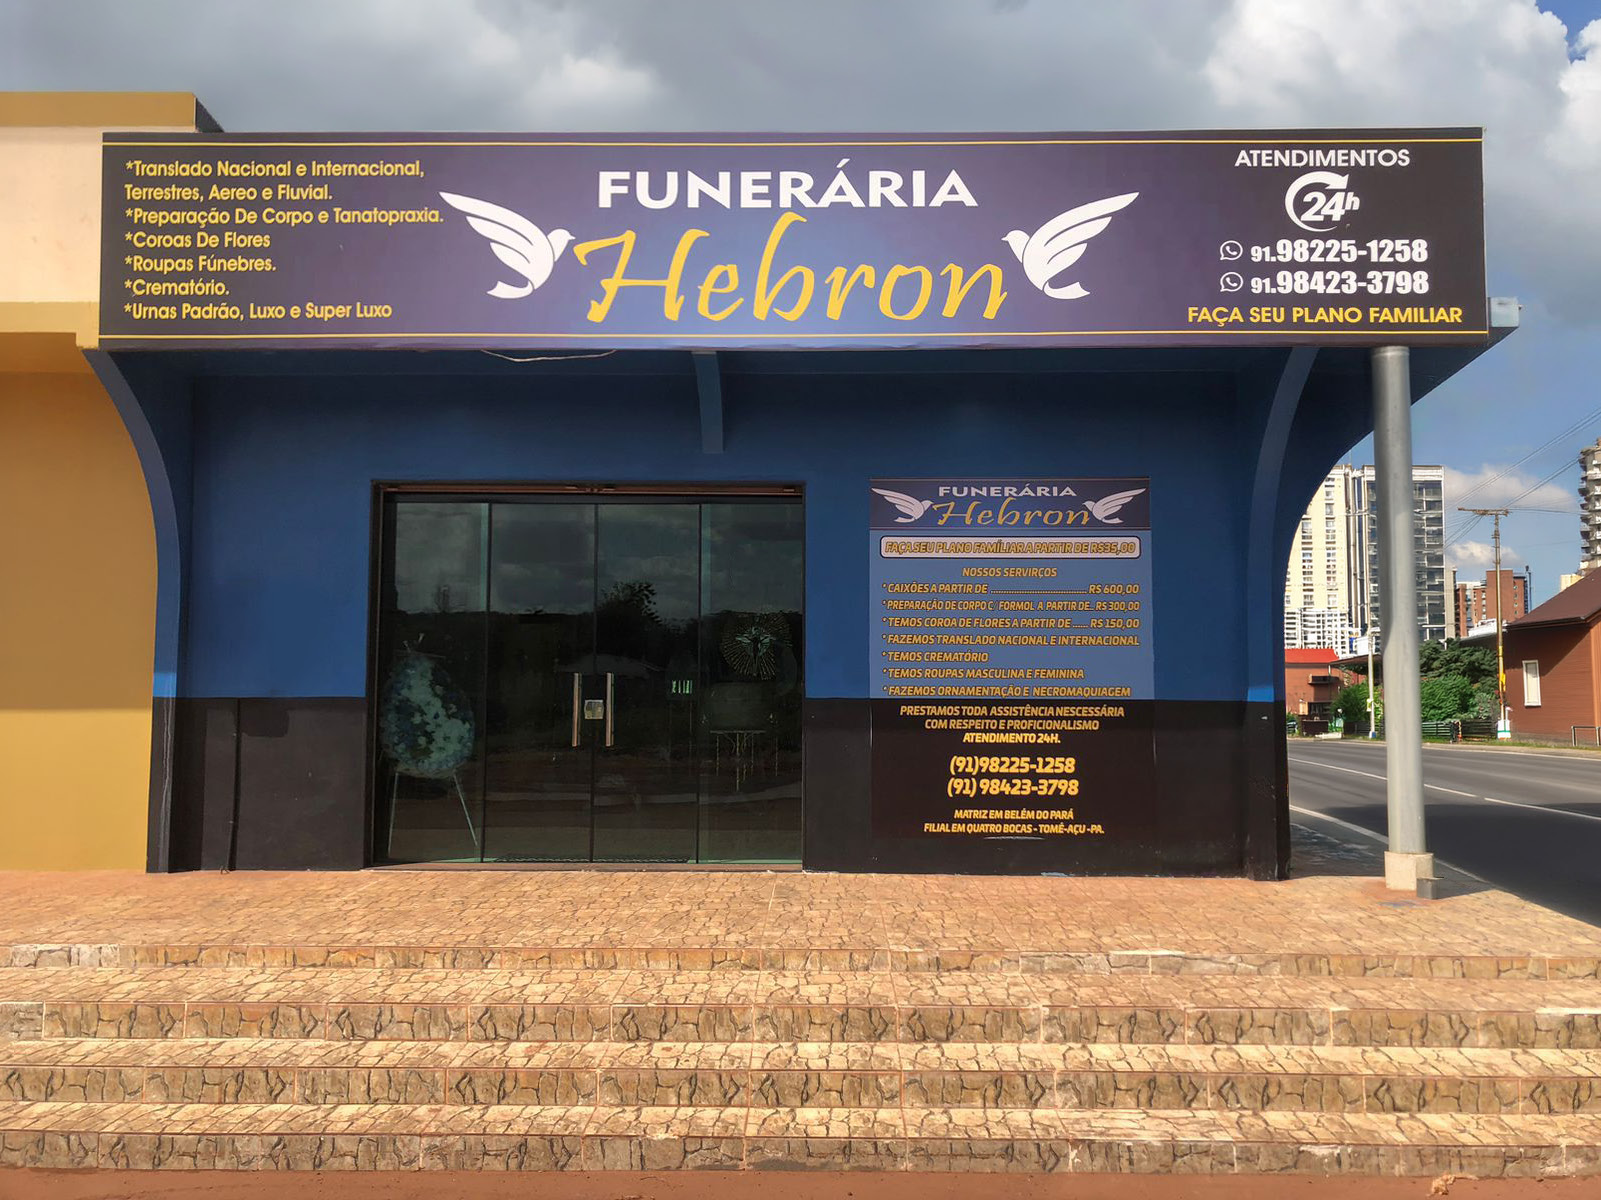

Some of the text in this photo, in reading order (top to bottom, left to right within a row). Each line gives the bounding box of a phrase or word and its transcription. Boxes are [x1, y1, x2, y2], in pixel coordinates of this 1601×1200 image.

[1234, 149, 1411, 167] ATENDIMENTOS
[217, 160, 291, 177] Nacional
[296, 165, 307, 177] e
[312, 160, 425, 178] Internacional,
[598, 158, 979, 209] FUNERÁRIA
[124, 184, 333, 202] Terrestres, Aereo e Fluvial.
[1300, 191, 1361, 222] 24h
[235, 208, 258, 224] De
[262, 208, 313, 226] Corpo
[318, 212, 329, 224] e
[333, 207, 444, 226] Tanatopraxia.
[196, 231, 219, 248] De
[224, 231, 271, 248] Flores
[1250, 239, 1428, 263] 91.98225-1258
[198, 254, 276, 272] Fúnebres.
[572, 211, 1008, 323] Hebron
[1250, 270, 1429, 295] 91.98423-3798
[181, 302, 244, 320] Padrão,
[249, 303, 286, 319] Luxo
[290, 307, 301, 319] e
[305, 302, 352, 322] Super
[356, 302, 392, 318] Luxo
[1187, 306, 1464, 328] FAÇA SEU PLANO FAMILIAR
[938, 483, 1077, 497] FUNERÁRIA
[931, 496, 1090, 525] Hebron
[884, 541, 912, 555] FAÇA
[912, 541, 935, 553] SEU
[936, 541, 972, 553] PLANO
[1025, 541, 1033, 553] A
[1034, 541, 1072, 553] PARTIR
[1074, 541, 1088, 553] DE
[962, 567, 1058, 579] NOSSOS SERVIRÇOS
[887, 582, 929, 594] CAIXÕES
[930, 584, 937, 593] A
[939, 584, 972, 593] PARTIR
[974, 584, 988, 594] DE
[1103, 584, 1139, 596] 600,00
[887, 599, 943, 611] PREPARAÇÃO
[945, 600, 957, 610] DE
[958, 601, 985, 610] CORPO
[998, 601, 1035, 611] FORMOL
[1037, 601, 1044, 611] A
[1046, 601, 1077, 611] PARTIR
[1108, 601, 1140, 613] 300,00
[888, 617, 922, 627] TEMOS
[924, 617, 959, 627] COROA
[959, 618, 972, 627] DE
[973, 618, 1010, 628] FLORES
[1011, 618, 1019, 628] A
[1020, 618, 1055, 628] PARTIR
[1057, 618, 1071, 628] DE
[1104, 618, 1140, 630] 150,00
[887, 634, 1140, 645] FAZEMOS TRANSLADO NACIONAL E INTERNACIONAL
[888, 649, 989, 662] TEMOS CREMATÓRIO
[888, 668, 1084, 679] TEMOS ROUPAS MASCULINA E FEMININA
[888, 684, 1131, 698] FAZEMOS ORNAMENTAÇÃO E NECROMAQUIAGEM
[900, 704, 1124, 717] PRESTAMOS TODA ASSISTÊNCIA NESCESSÁRIA
[924, 719, 1099, 730] COM RESPEITO E PROFICIONALISMO
[962, 733, 1061, 743] ATENDIMENTO 24H.
[947, 778, 1079, 797] (91) 98423-3798
[954, 808, 1074, 820] MATRIZ EM BELÉM DO PARÁ
[924, 823, 951, 833] FILIAL
[951, 823, 966, 833] EM
[966, 823, 1002, 835] QUATRO
[1003, 824, 1032, 834] BOCAS
